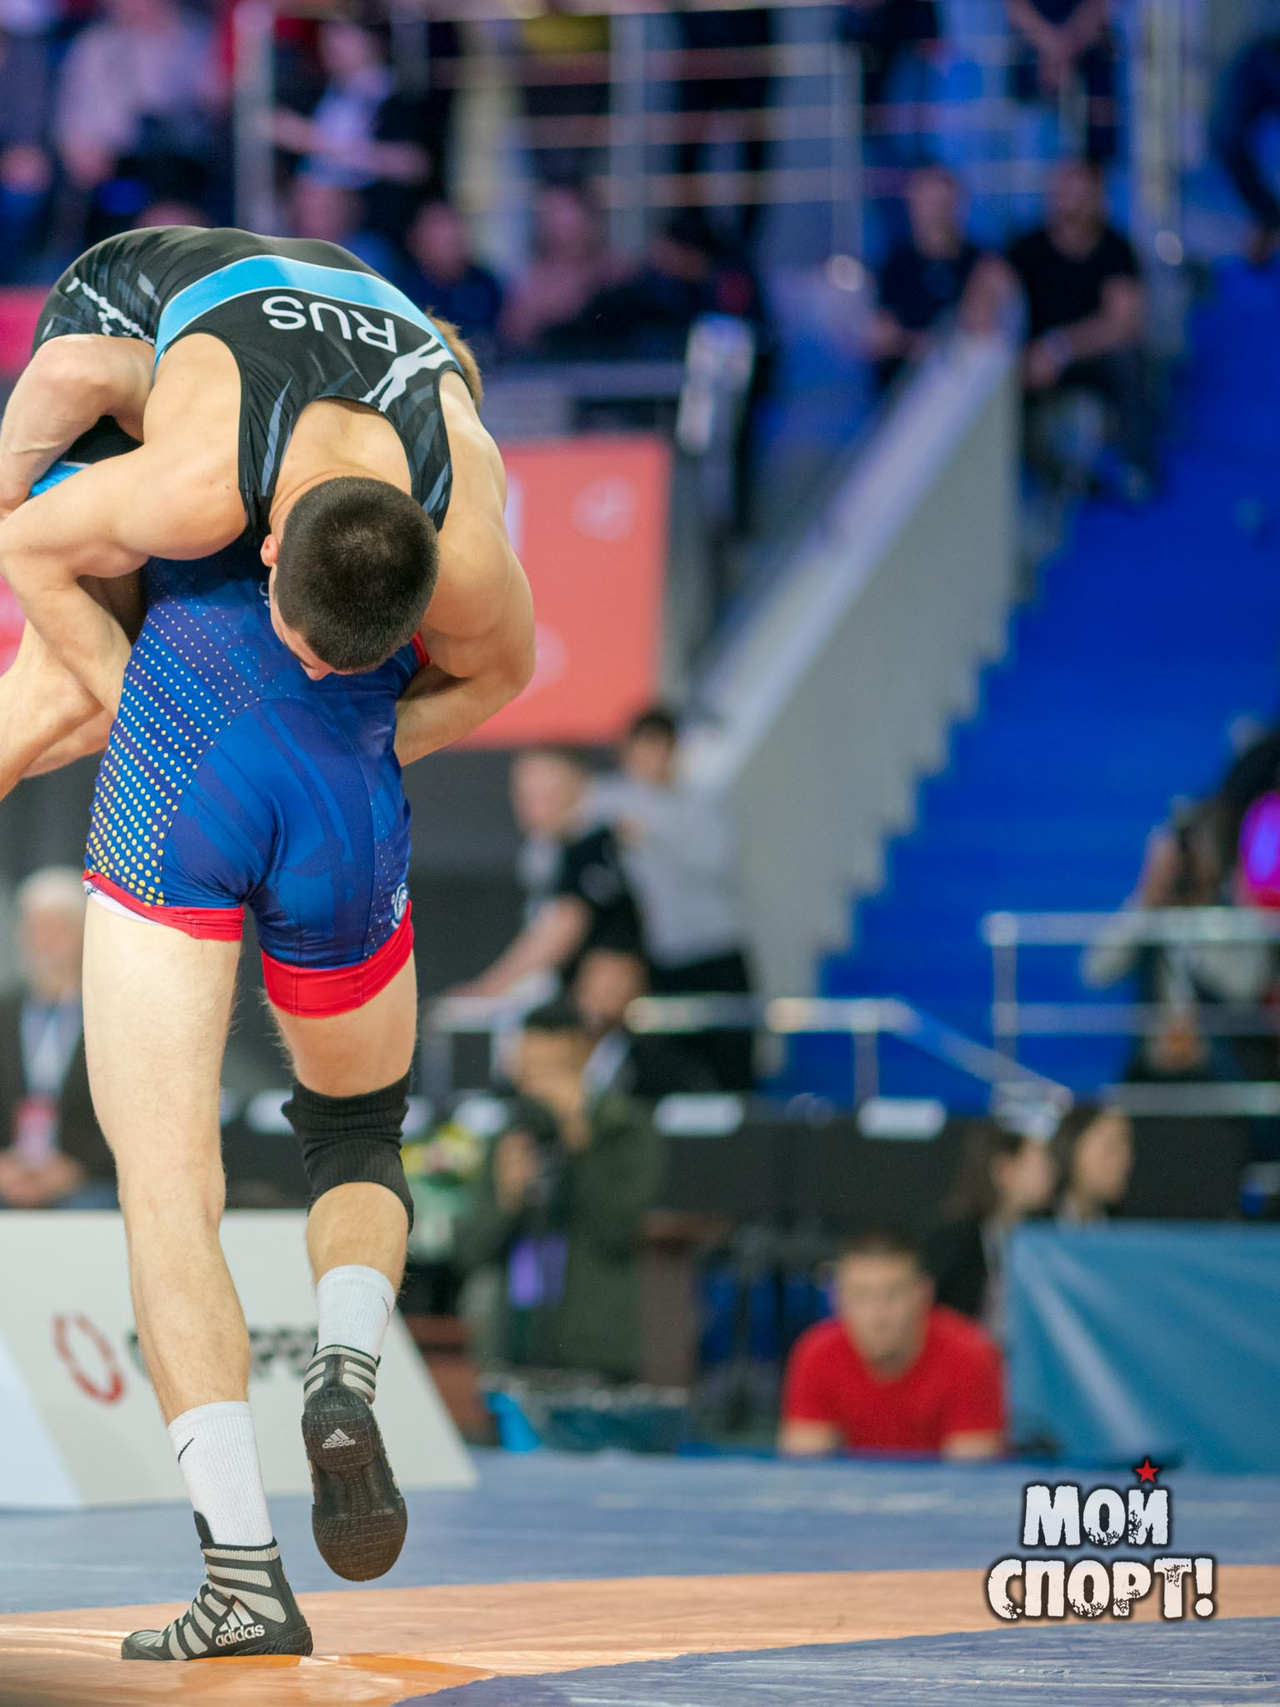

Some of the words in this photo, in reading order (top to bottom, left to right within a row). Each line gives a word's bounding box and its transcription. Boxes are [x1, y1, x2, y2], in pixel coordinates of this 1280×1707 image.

[262, 296, 397, 353] RUS
[322, 1439, 356, 1449] adidas
[215, 1623, 266, 1647] adidas
